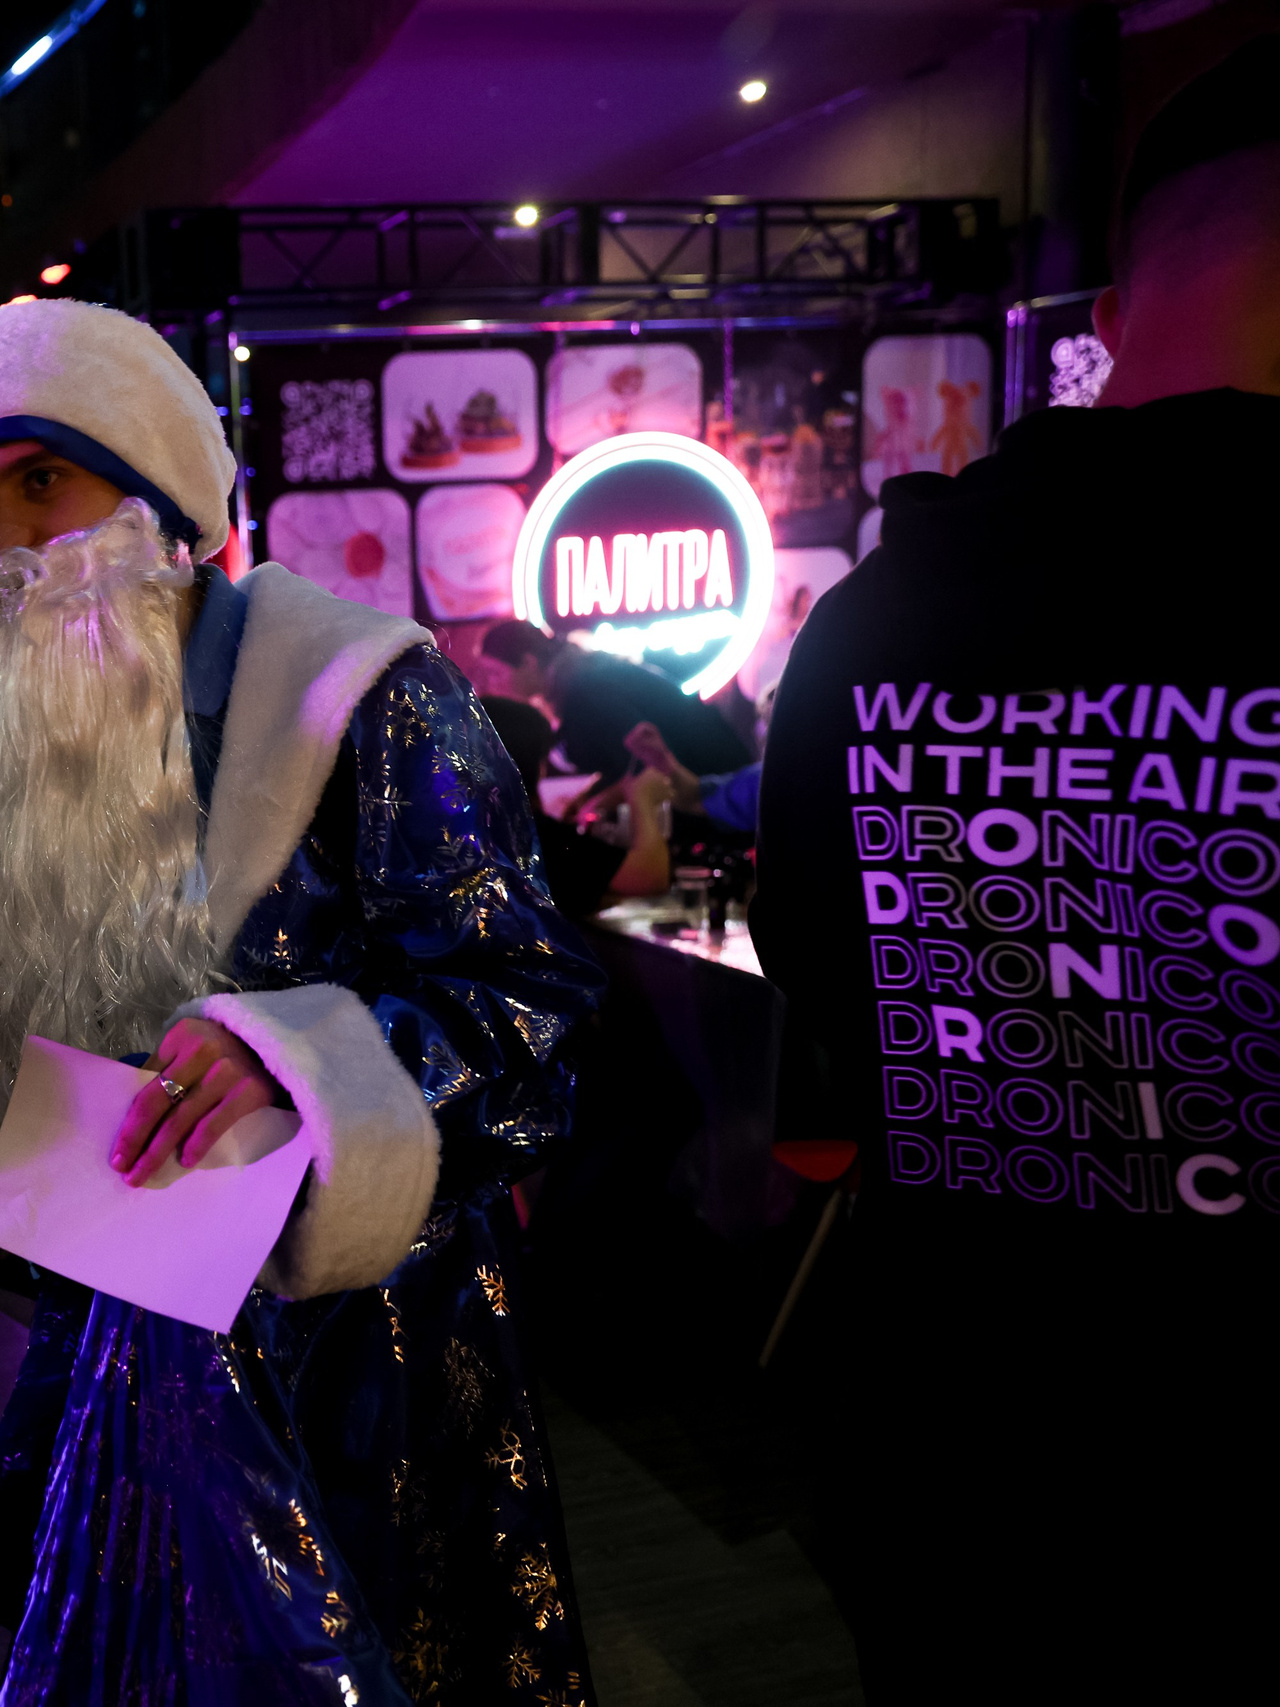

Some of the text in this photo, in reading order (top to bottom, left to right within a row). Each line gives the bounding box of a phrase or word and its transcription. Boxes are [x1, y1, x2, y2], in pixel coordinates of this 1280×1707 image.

[555, 528, 735, 618] ПАЛИТРА
[852, 681, 1280, 748] WORKING
[846, 743, 1280, 822] IN THE AIR
[851, 804, 1280, 898] DRONICO
[860, 869, 1280, 968] DRONICO
